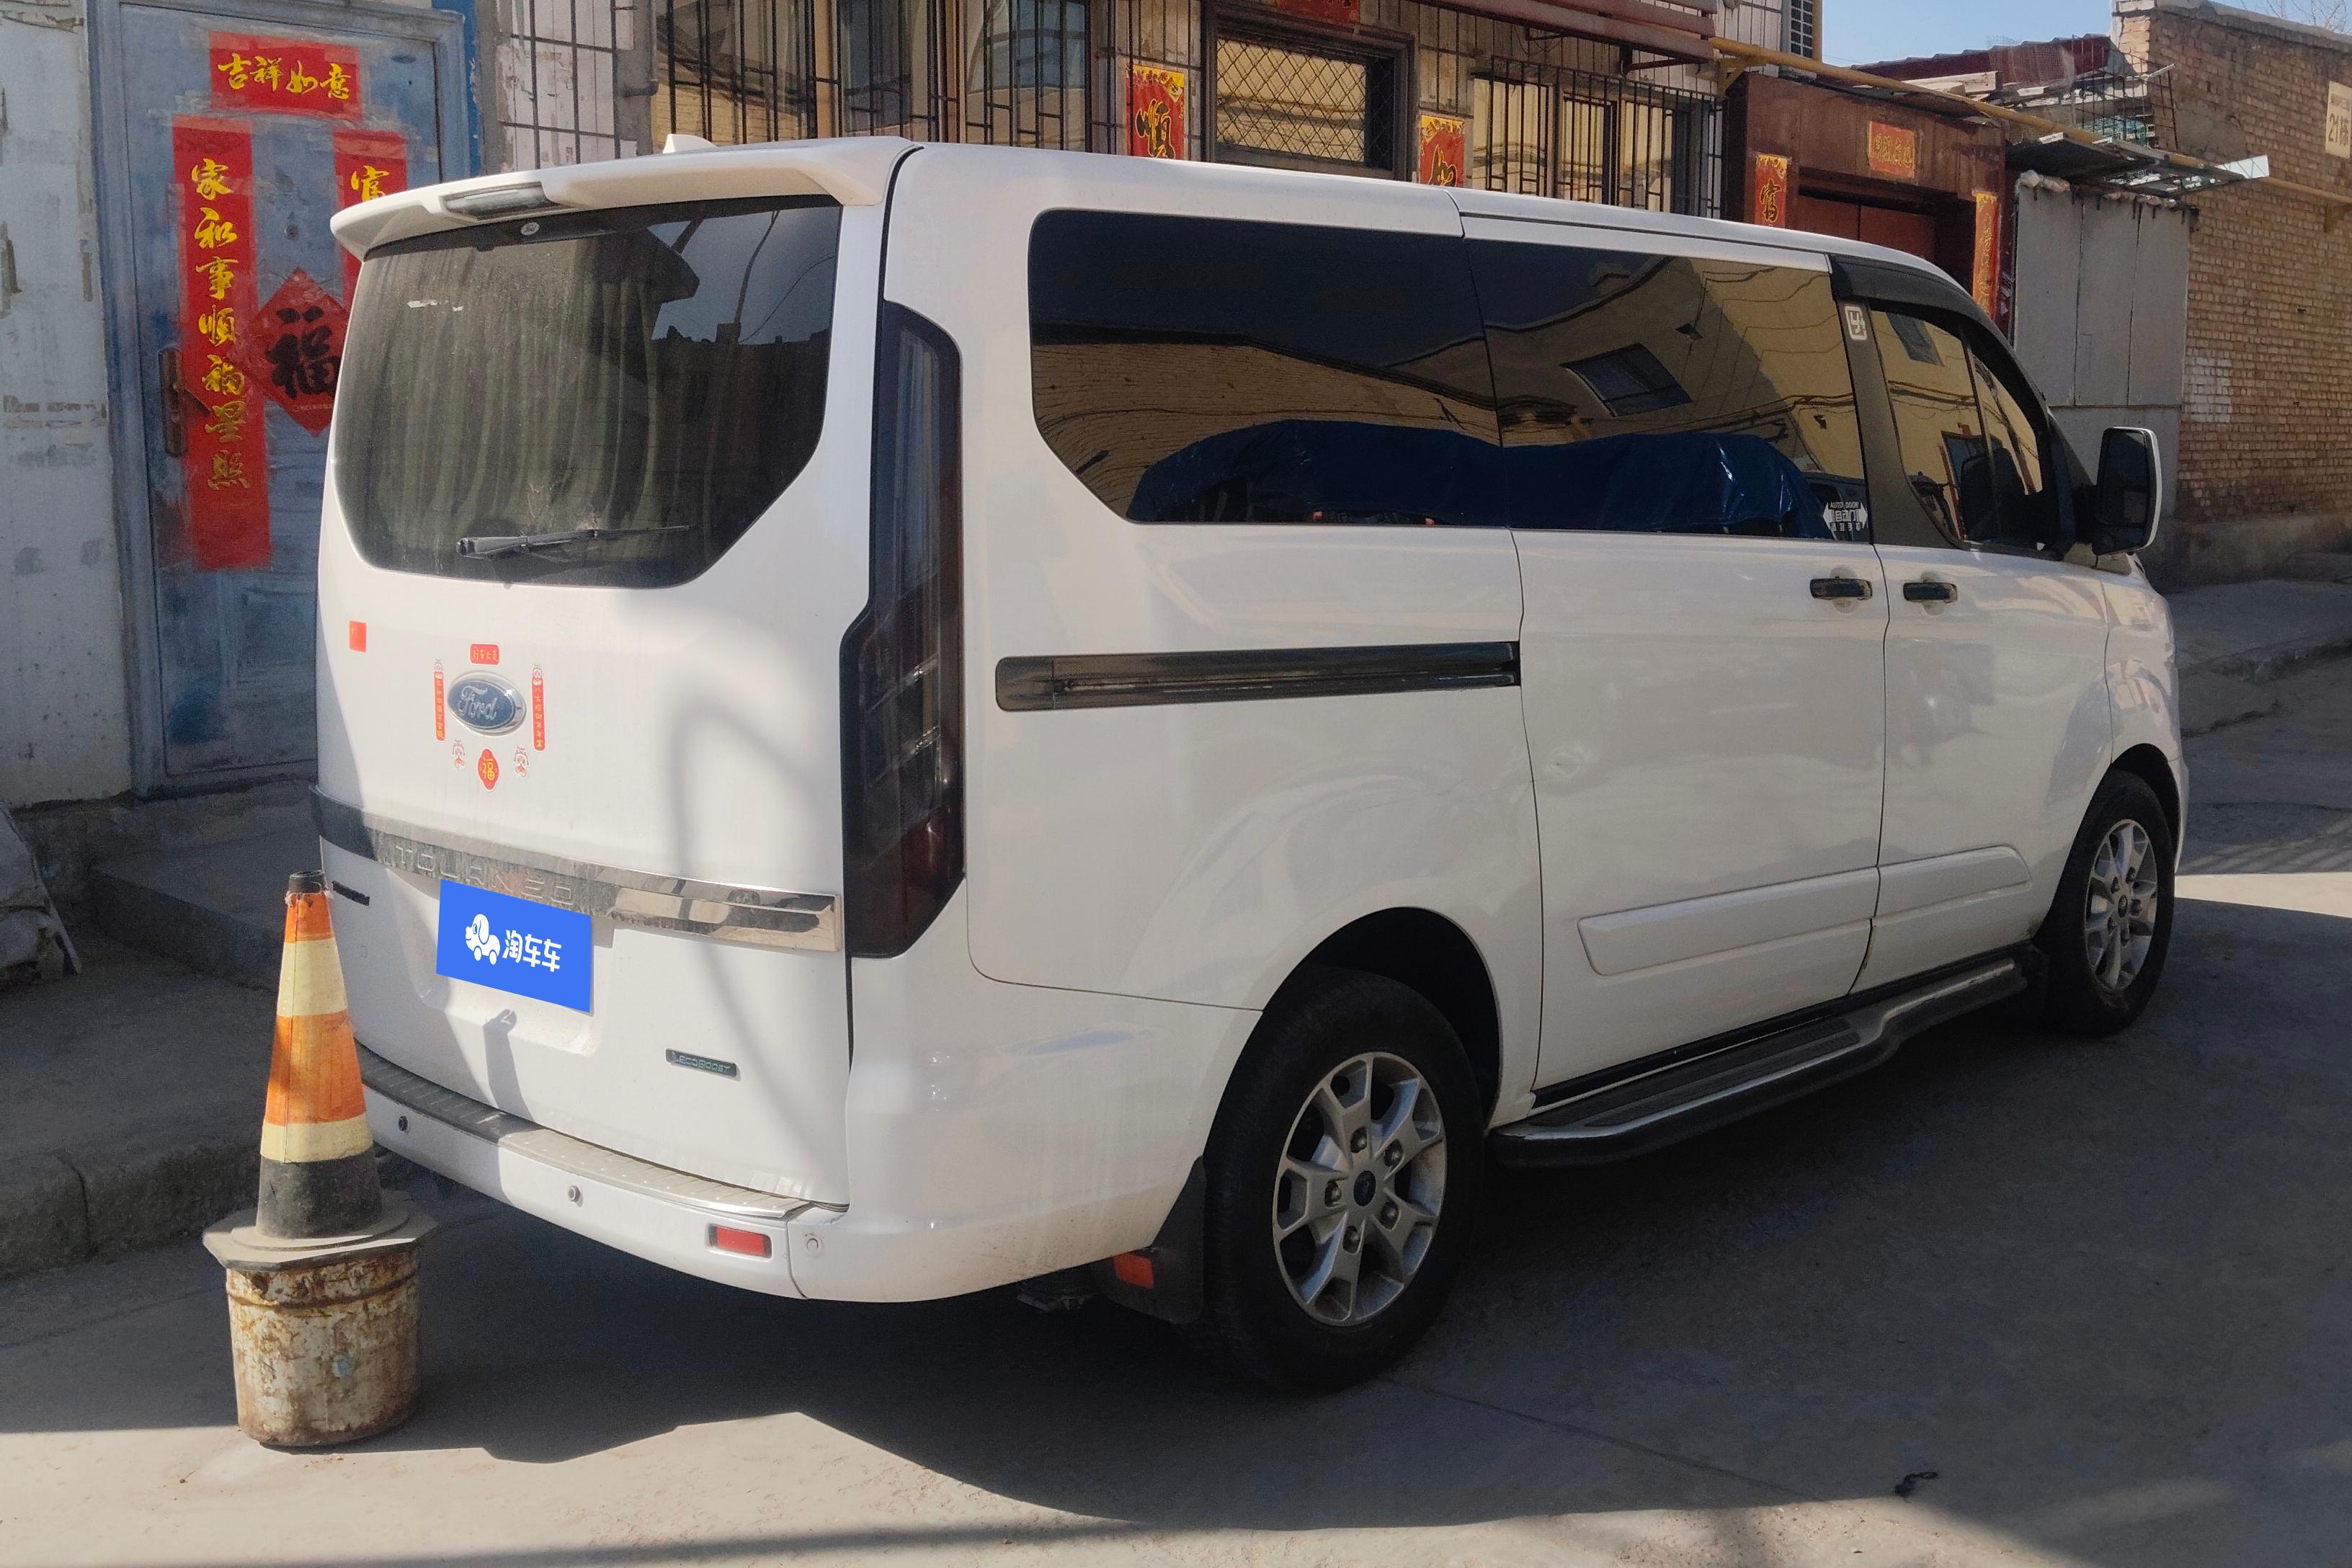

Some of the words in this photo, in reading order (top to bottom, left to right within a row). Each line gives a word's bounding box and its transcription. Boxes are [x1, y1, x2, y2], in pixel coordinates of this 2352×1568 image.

[218, 52, 352, 99] 吉祥如意
[264, 305, 342, 399] 福
[457, 685, 497, 721] Ford
[482, 756, 496, 781] 福
[395, 845, 574, 906] TOURNEO
[679, 1054, 731, 1073] ECOBOOST
